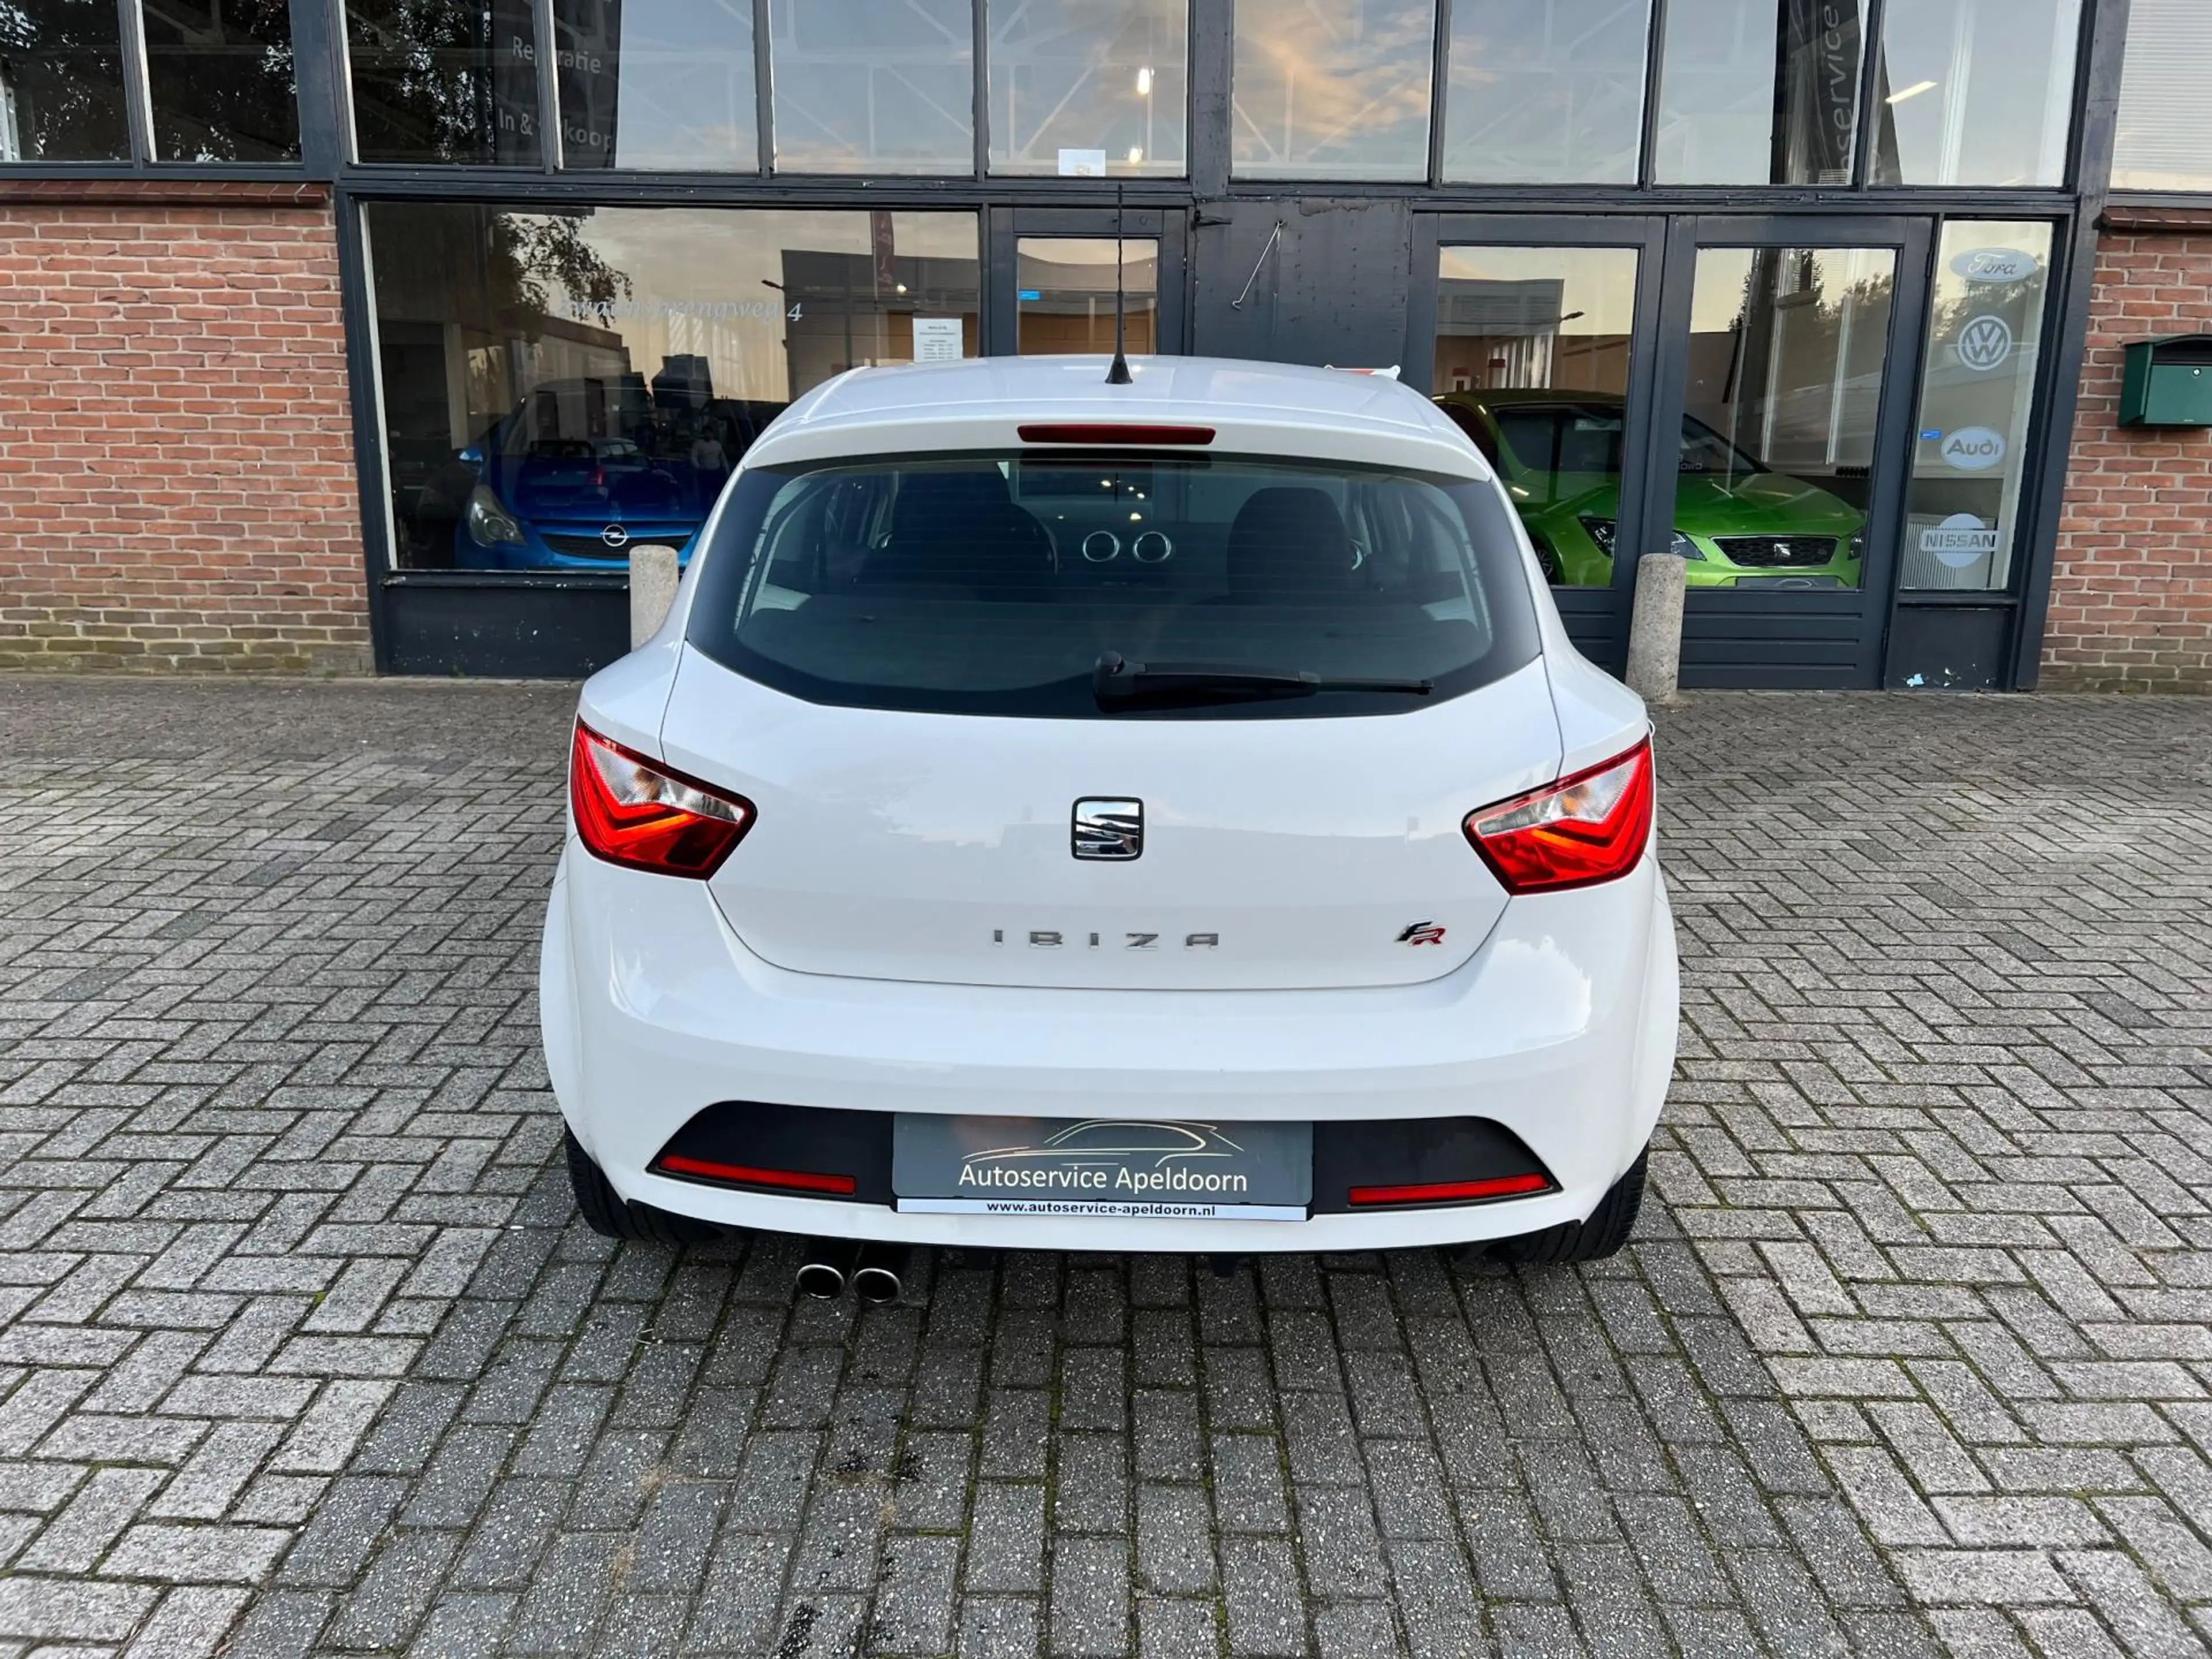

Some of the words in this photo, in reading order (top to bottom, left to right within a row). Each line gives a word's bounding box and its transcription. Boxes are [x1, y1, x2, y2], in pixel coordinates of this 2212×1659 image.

[512, 35, 601, 74] Reratie
[499, 108, 514, 131] In
[520, 113, 533, 135] &
[787, 302, 803, 321] 4
[1946, 439, 1999, 456] Audi
[1925, 533, 1996, 548] NISSAN
[994, 929, 1219, 950] IBIZA
[1395, 920, 1446, 946] FR
[958, 1164, 1107, 1189] Autoservice
[1115, 1166, 1248, 1194] Apeldoorn
[986, 1202, 1215, 1217] www.autoservice-apeldoorn.nl
